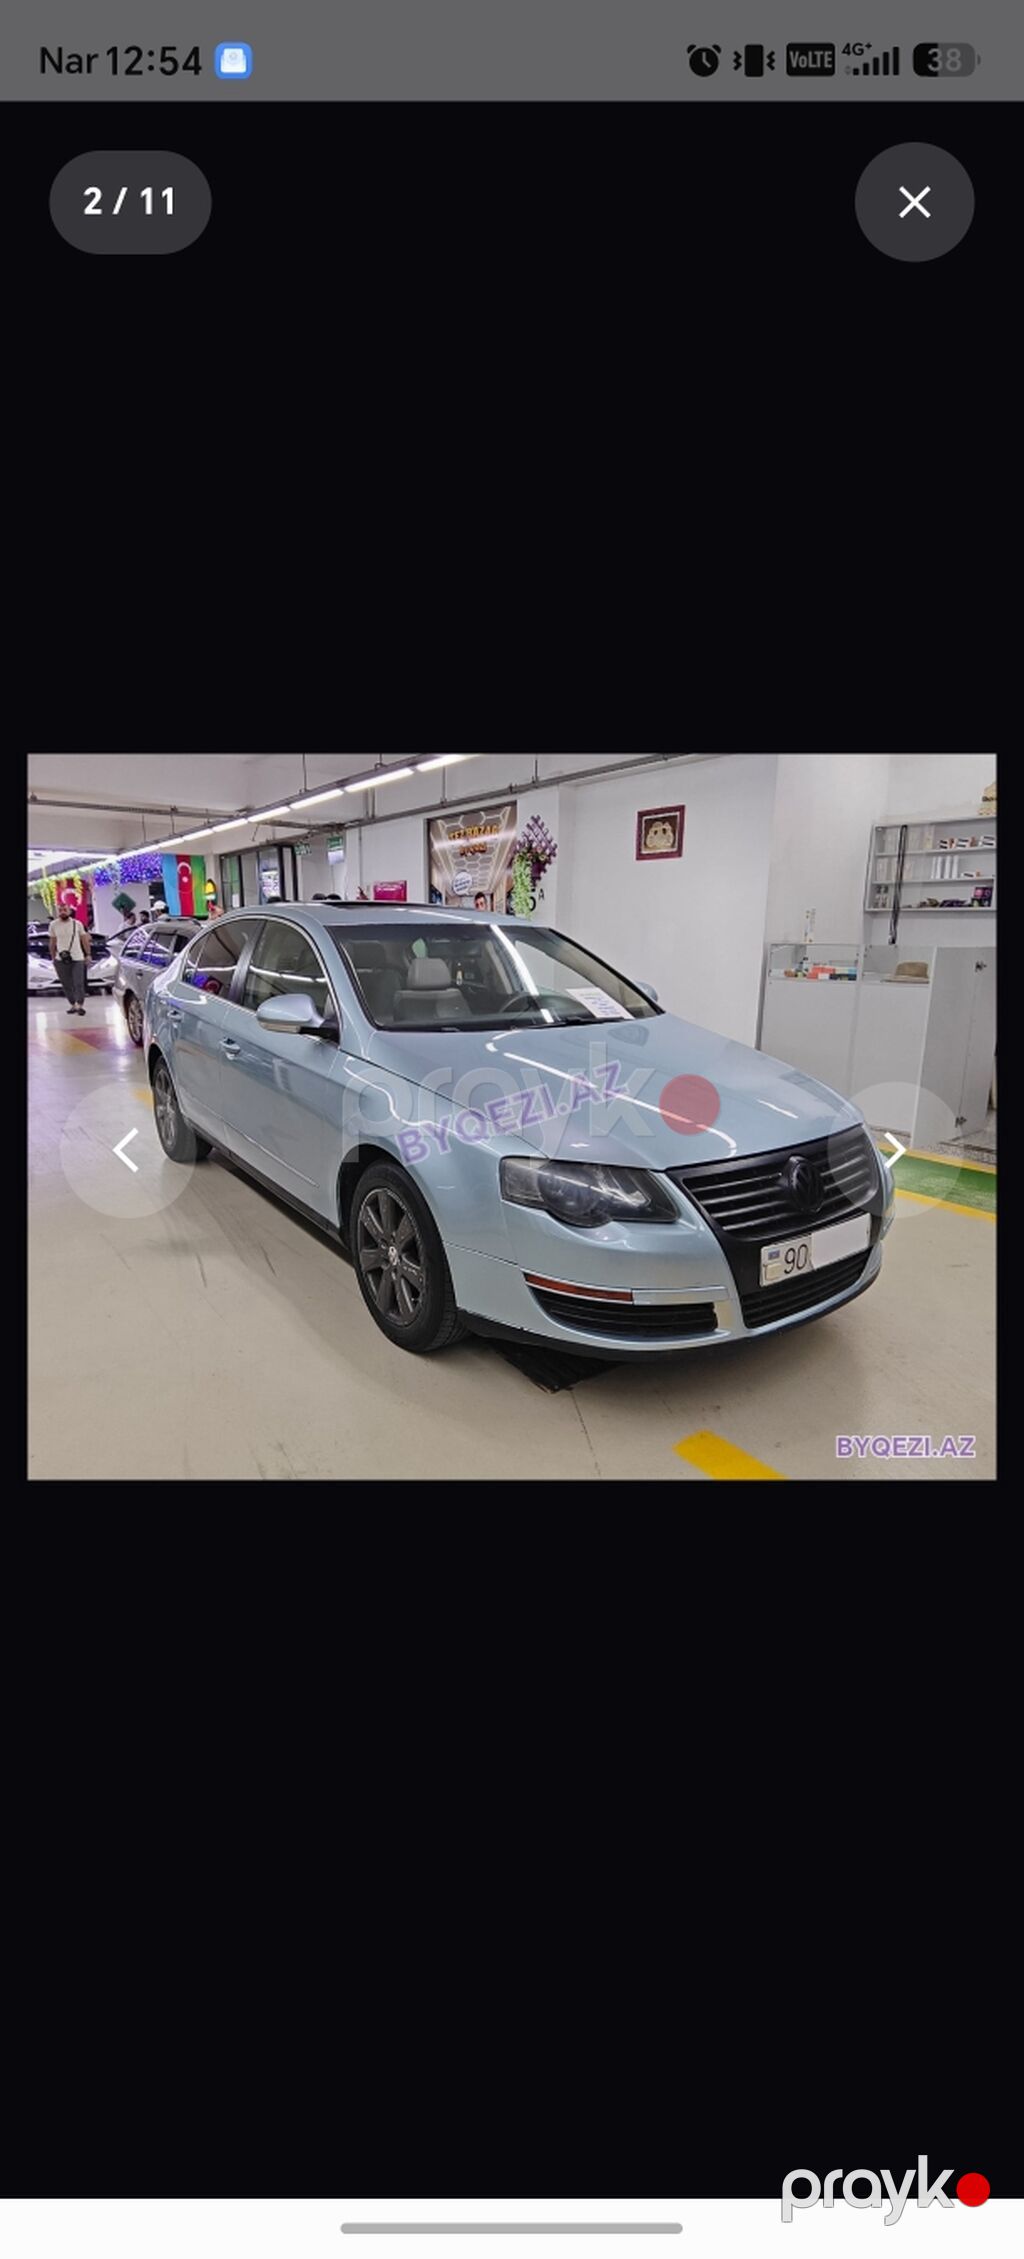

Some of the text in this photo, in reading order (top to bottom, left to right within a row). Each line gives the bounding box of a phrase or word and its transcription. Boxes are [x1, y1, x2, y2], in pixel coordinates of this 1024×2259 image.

[40, 46, 202, 76] Nar 12:54
[789, 51, 833, 69] VoLTE
[928, 49, 962, 72] 38
[83, 187, 102, 215] 2
[140, 187, 173, 215] 11
[784, 1244, 808, 1274] 90
